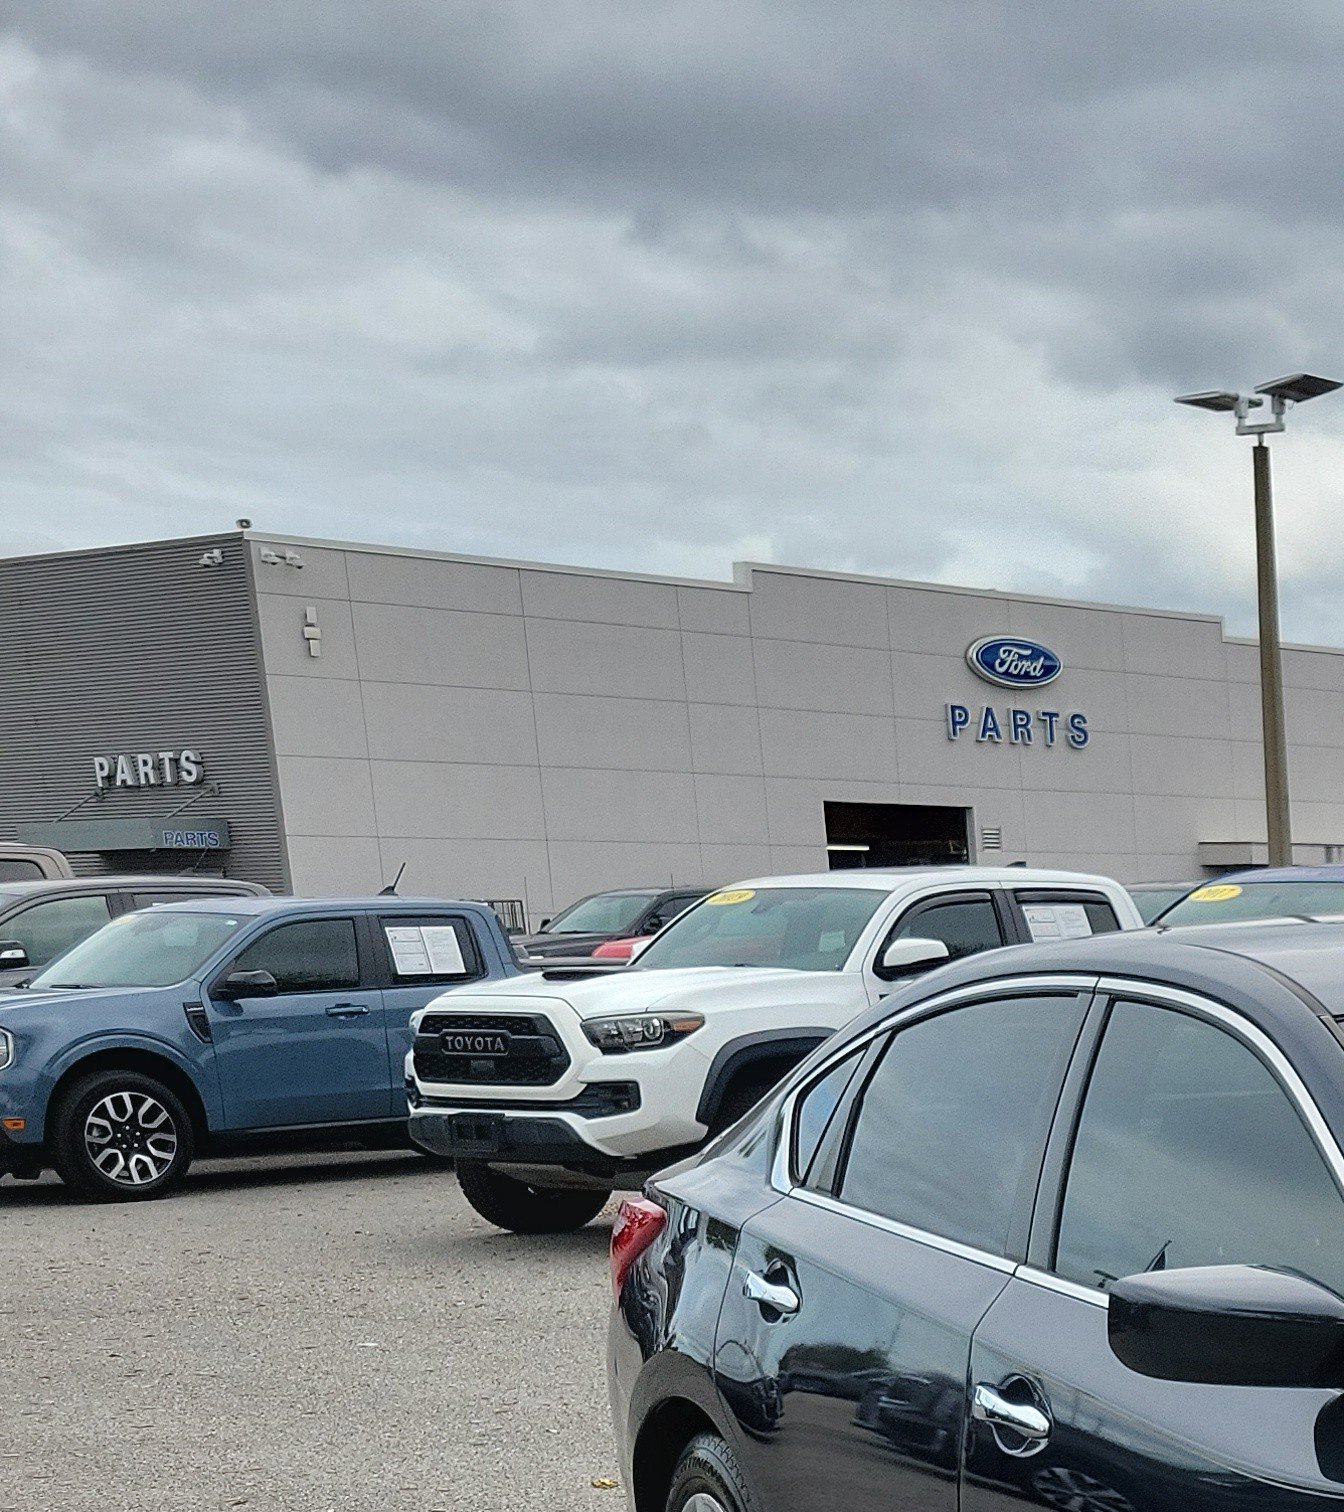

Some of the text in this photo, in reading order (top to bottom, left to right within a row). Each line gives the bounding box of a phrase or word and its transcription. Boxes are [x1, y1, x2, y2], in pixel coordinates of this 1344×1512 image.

[995, 646, 1045, 677] Ford
[945, 704, 1090, 749] PARTS
[93, 749, 200, 787] PARTS
[163, 830, 219, 847] PARTS
[445, 1035, 505, 1051] TOYOTA
